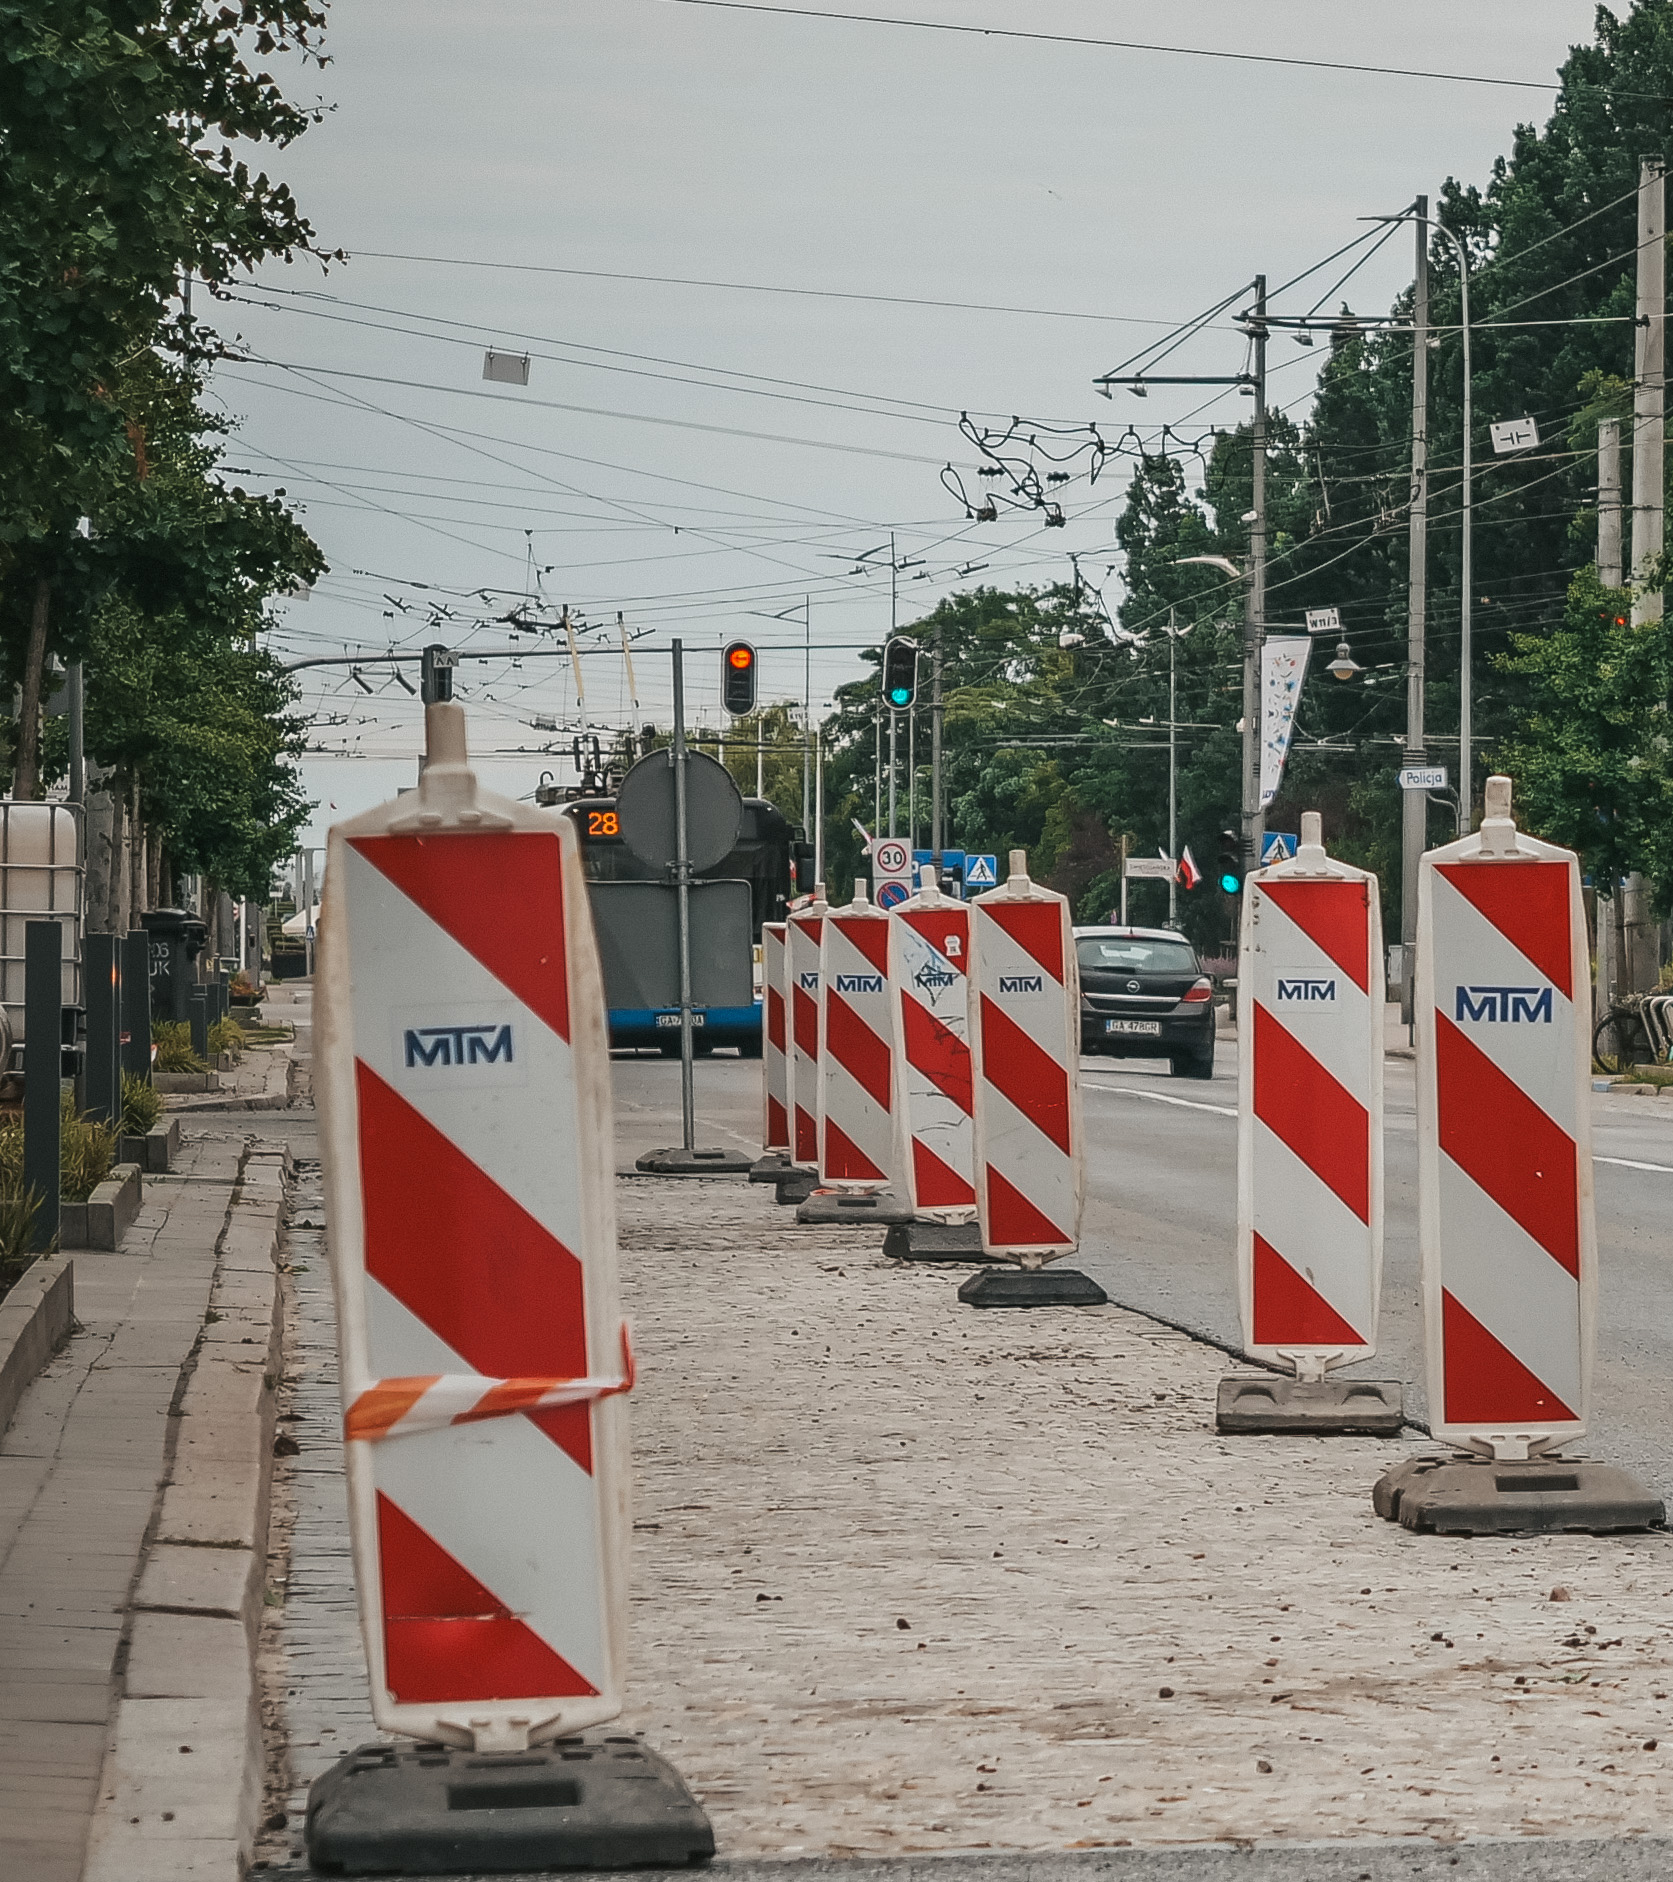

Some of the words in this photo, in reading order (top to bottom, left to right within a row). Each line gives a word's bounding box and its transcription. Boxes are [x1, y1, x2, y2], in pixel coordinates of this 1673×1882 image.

[1406, 771, 1443, 786] Policja
[588, 811, 620, 836] 28
[881, 850, 903, 866] 30
[837, 974, 883, 993] MTM
[917, 973, 954, 988] MTM
[1000, 977, 1043, 993] MTM
[1278, 979, 1336, 1002] MTM
[1455, 985, 1553, 1023] MTM
[404, 1025, 514, 1068] MTM
